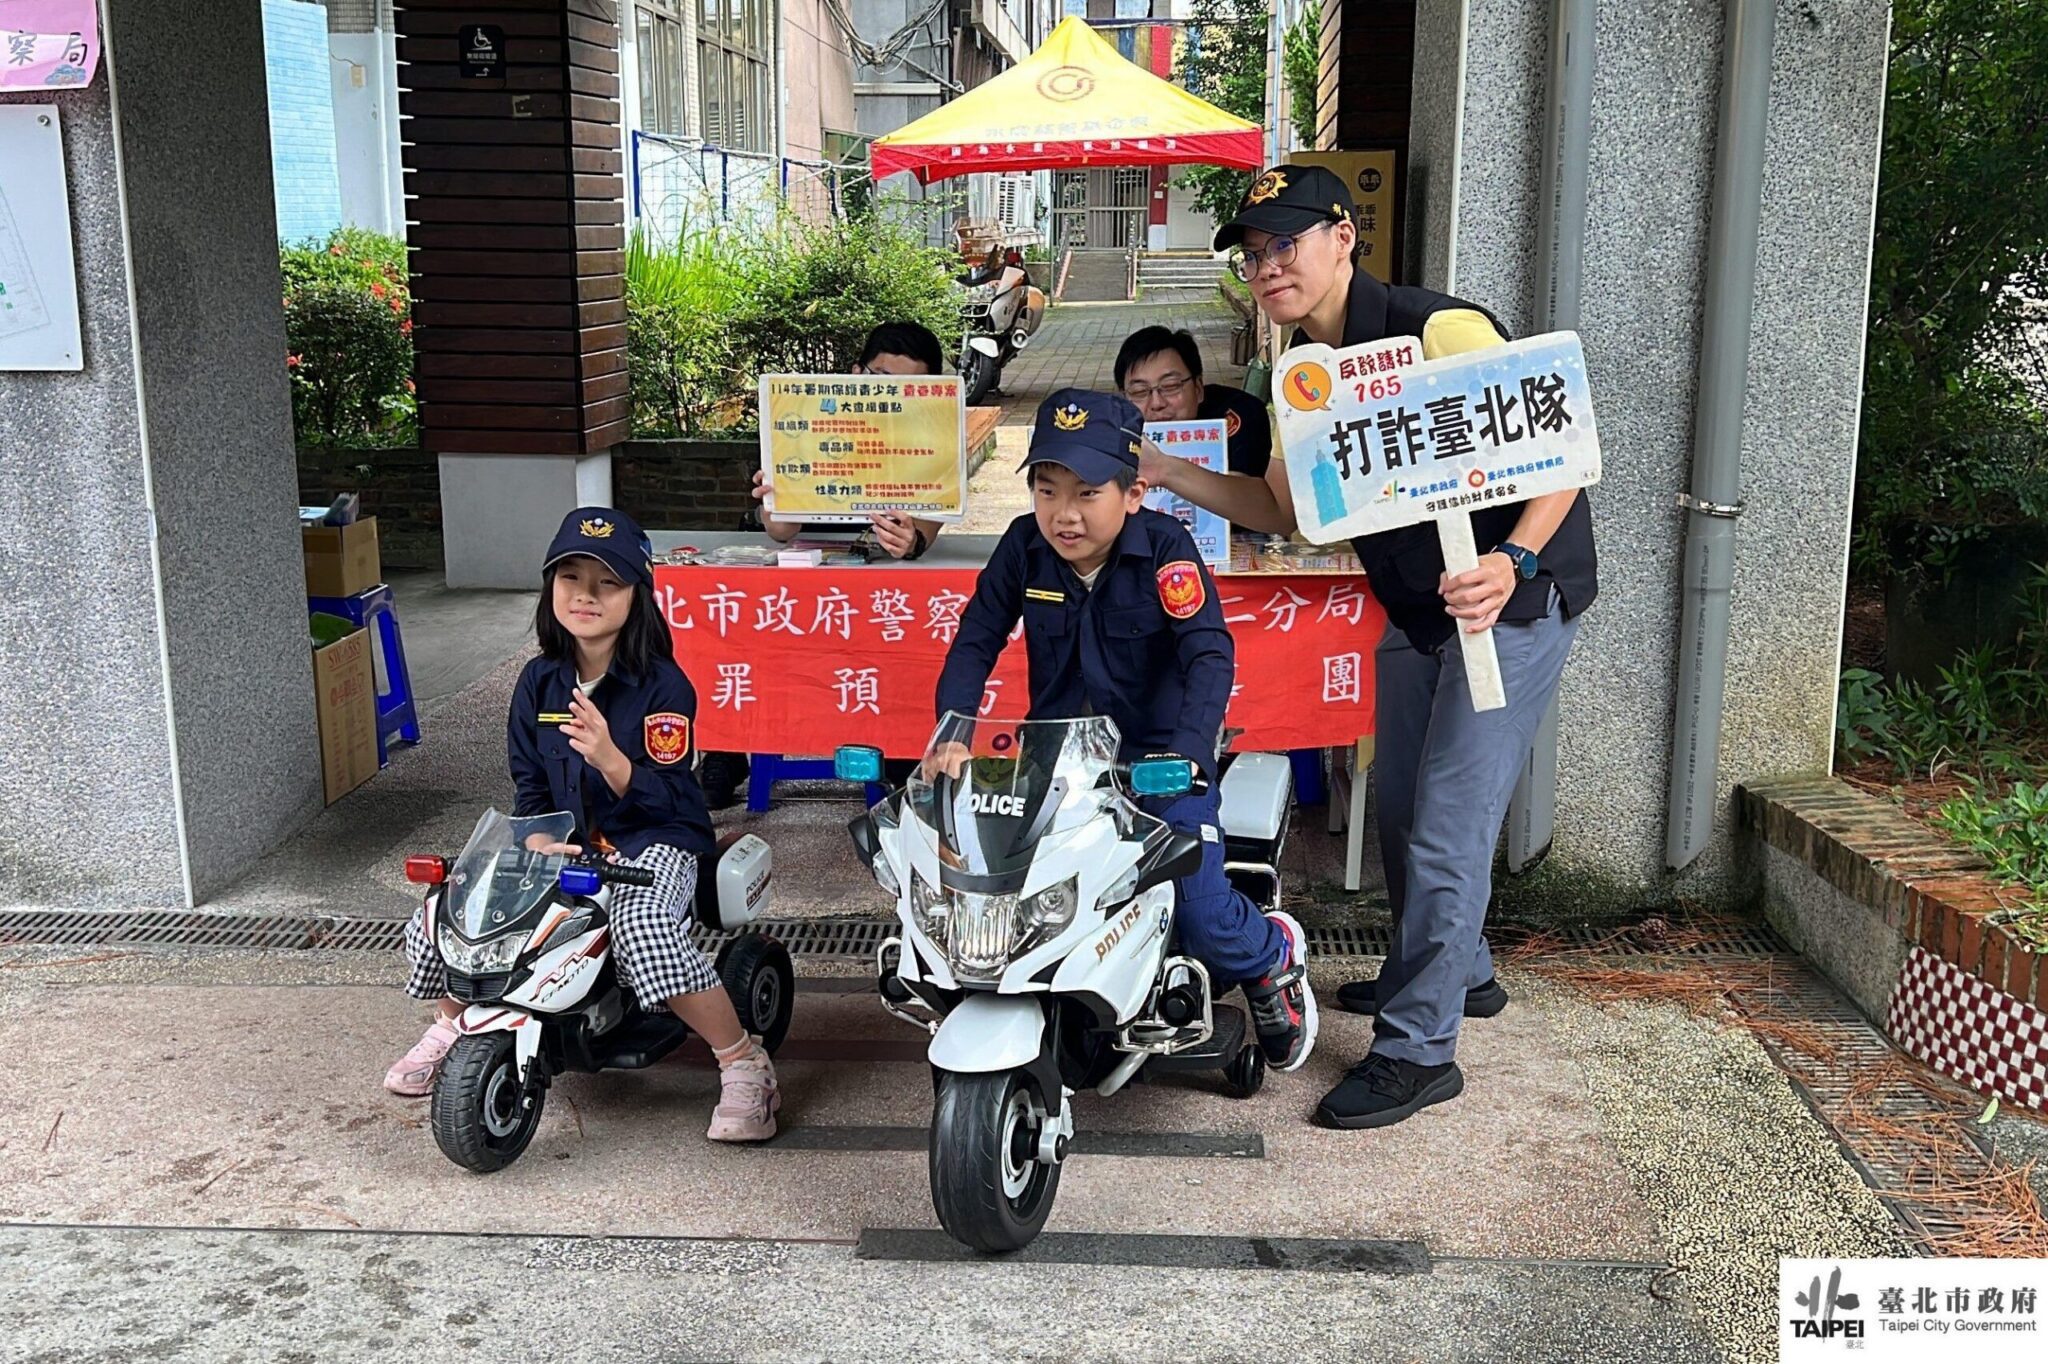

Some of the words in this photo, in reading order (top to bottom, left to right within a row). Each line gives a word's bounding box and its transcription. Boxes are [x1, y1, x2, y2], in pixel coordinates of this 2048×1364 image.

[1354, 375, 1402, 403] 165
[1329, 371, 1573, 481] 打詐臺北隊
[1409, 478, 1459, 499] 臺北市政府
[654, 583, 1024, 644] 北市政府警察
[1322, 651, 1362, 704] 團
[958, 790, 1027, 818] POLICE
[1094, 903, 1142, 962] POLICE
